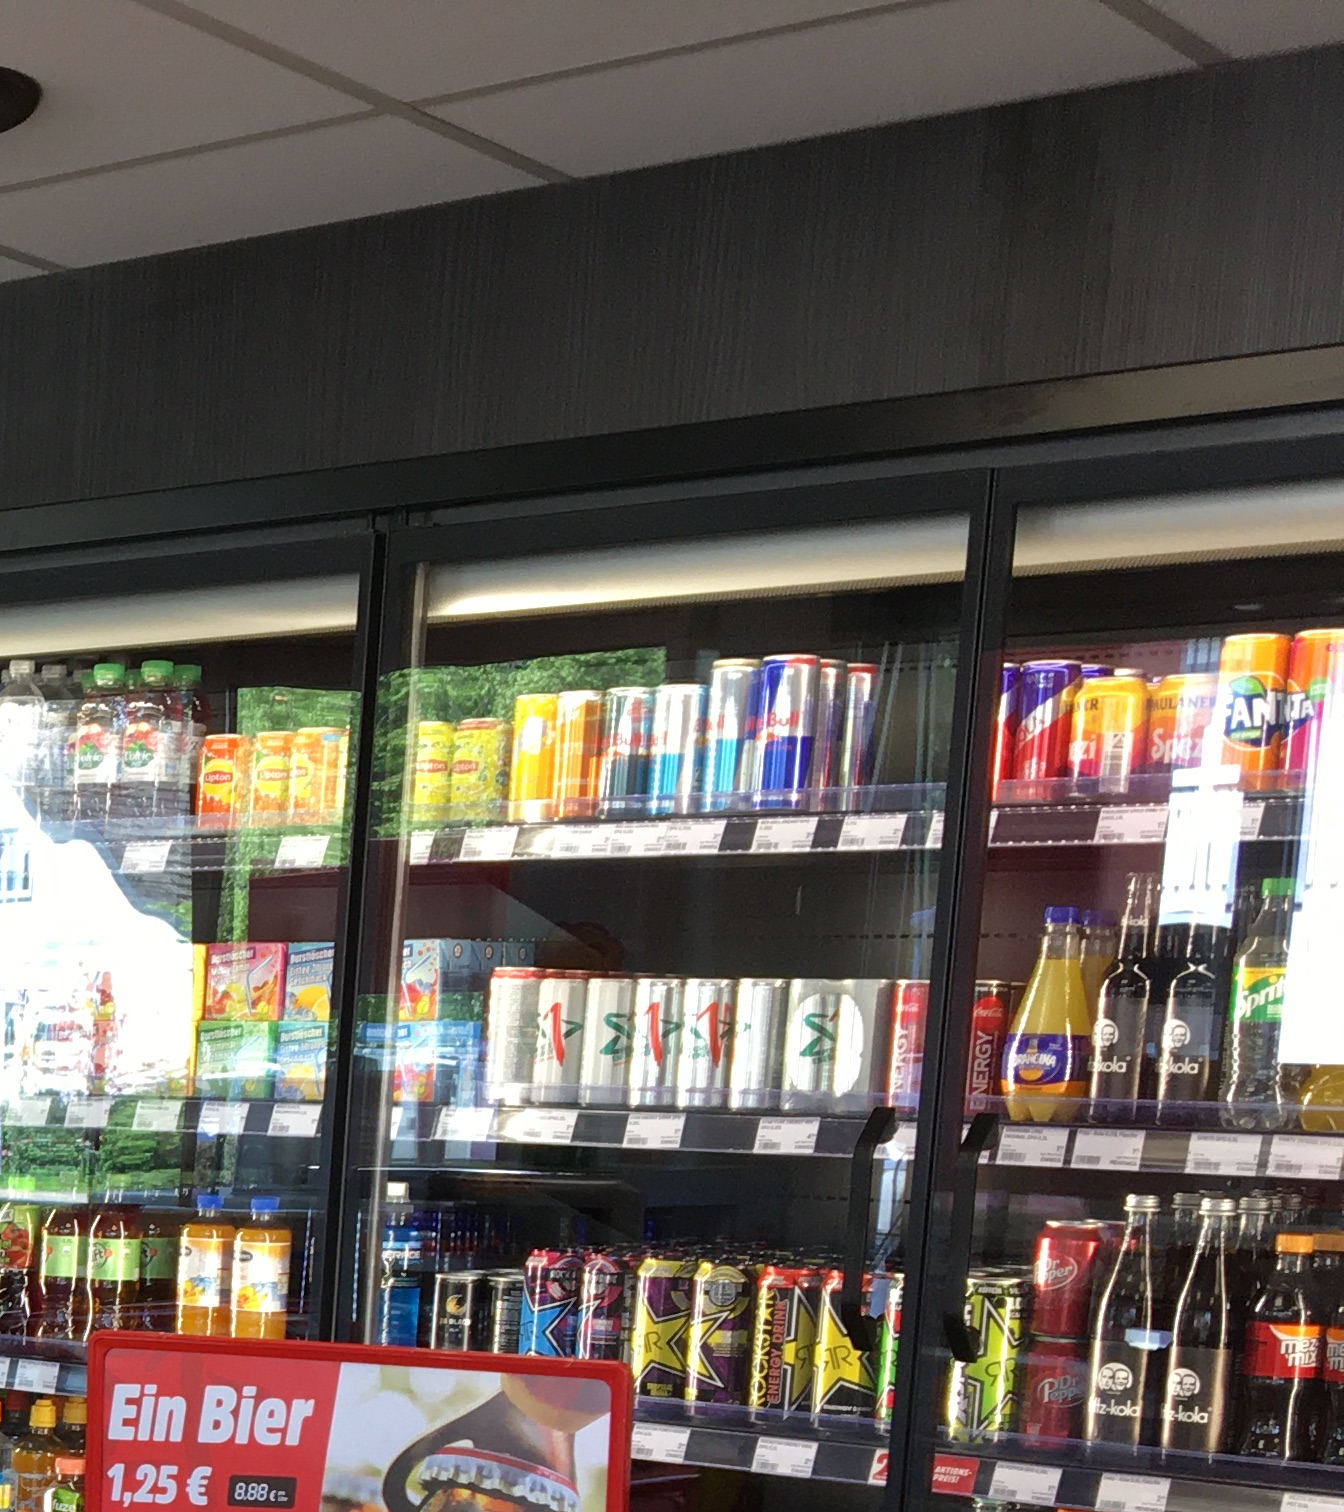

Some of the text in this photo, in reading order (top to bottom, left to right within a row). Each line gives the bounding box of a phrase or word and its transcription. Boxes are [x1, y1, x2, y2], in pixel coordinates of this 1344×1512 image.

[204, 771, 234, 785] Lipton
[970, 1030, 993, 1111] ENERGY
[1042, 1255, 1060, 1273] Dr
[767, 1299, 786, 1404] ENERGY DRINK
[109, 1382, 314, 1446] Ein Bier
[106, 1463, 212, 1506] 1,25 €
